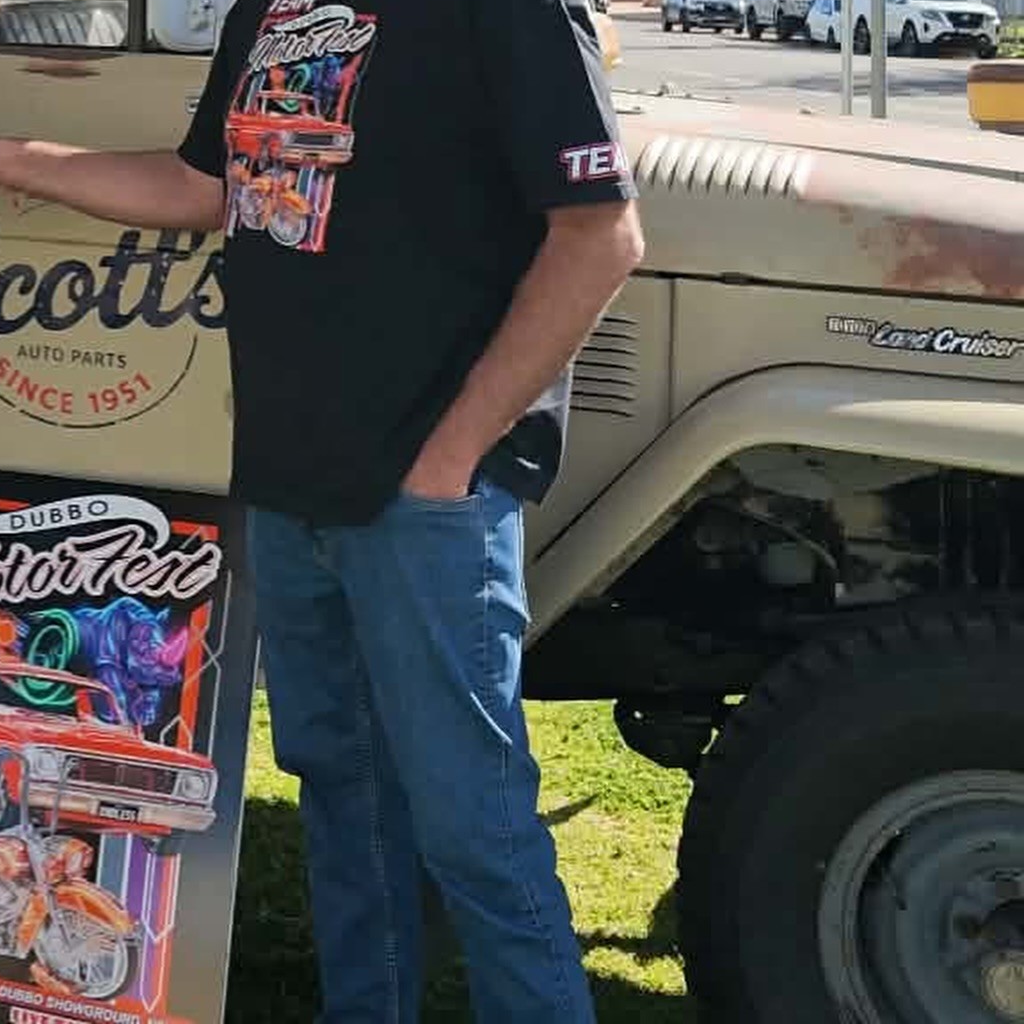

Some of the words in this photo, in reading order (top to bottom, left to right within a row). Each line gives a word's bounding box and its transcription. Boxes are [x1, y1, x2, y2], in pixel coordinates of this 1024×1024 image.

[17, 344, 65, 364] AUTO
[71, 347, 127, 370] PARTS
[933, 327, 1024, 357] Cruiser
[87, 372, 154, 414] 1951
[9, 499, 110, 531] DUBBO
